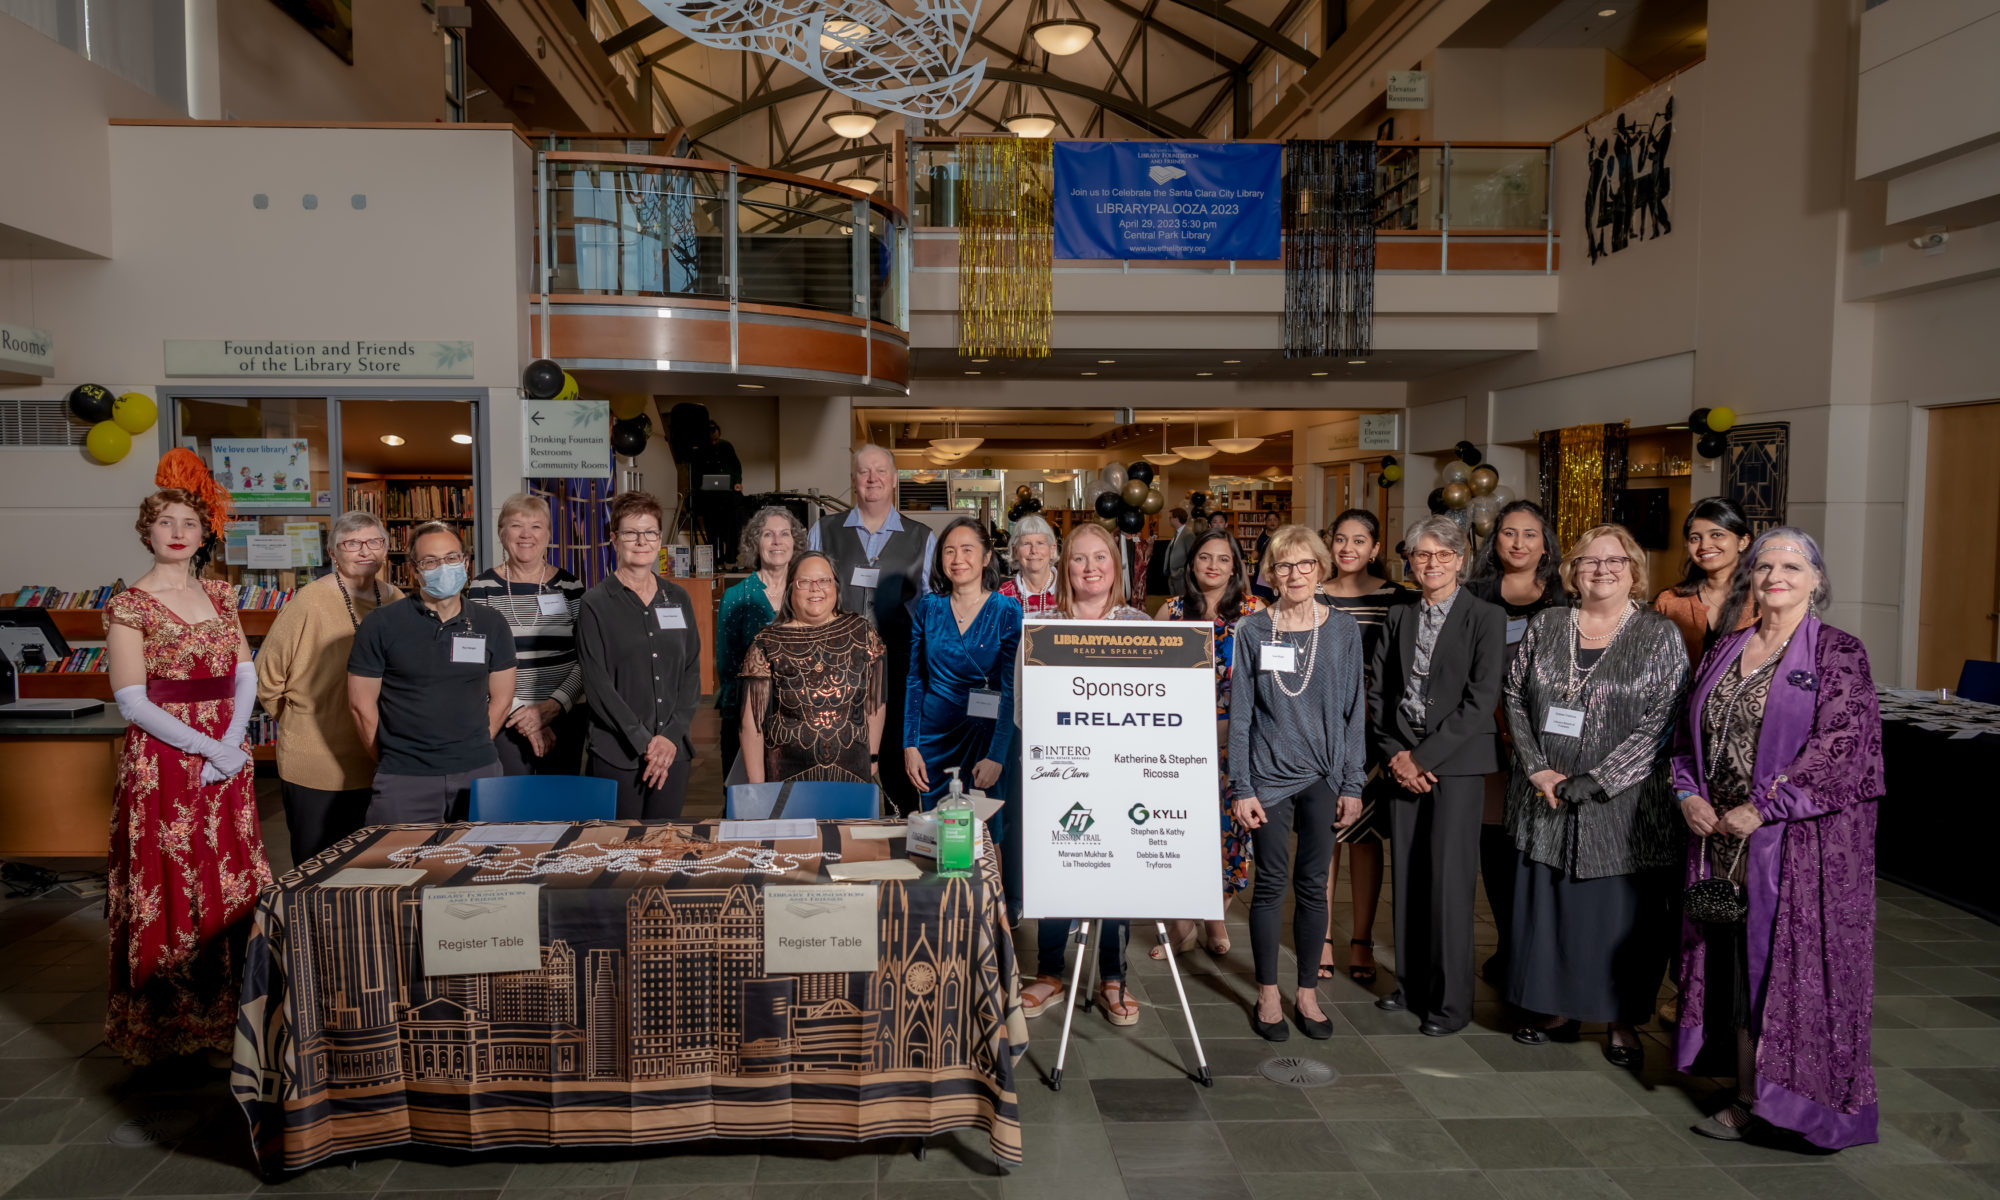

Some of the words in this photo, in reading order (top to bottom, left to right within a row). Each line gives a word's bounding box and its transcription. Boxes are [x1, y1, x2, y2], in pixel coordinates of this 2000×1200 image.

[1070, 188, 1087, 196] Join
[1112, 188, 1151, 197] Celebrate
[1153, 189, 1166, 198] the
[1169, 189, 1192, 198] Santa
[1194, 189, 1216, 198] Clara
[1218, 189, 1235, 200] City
[1237, 190, 1264, 200] Library
[1096, 203, 1207, 215] LIBRARYPALOOZA
[1210, 204, 1239, 215] 2023
[1119, 219, 1139, 230] April
[1141, 220, 1155, 230] 29,
[1158, 219, 1180, 228] 2023
[1182, 220, 1201, 228] 5:30
[1203, 222, 1217, 230] pm
[1124, 231, 1156, 239] Central
[1158, 231, 1178, 239] Park
[1181, 231, 1211, 241] Library
[2, 330, 46, 356] Rooms
[224, 341, 315, 355] Foundation
[322, 341, 350, 355] and
[357, 341, 415, 355] Friends
[239, 358, 256, 372] of
[262, 358, 287, 372] the
[294, 358, 351, 374] Library
[358, 358, 401, 372] Store
[530, 435, 566, 444] Drinking
[568, 435, 603, 443] Fountain
[261, 445, 288, 454] library!
[531, 461, 578, 470] Community
[581, 461, 608, 469] Rooms
[1054, 634, 1157, 646] LIBRARYPALOOZA
[1159, 636, 1183, 647] 2023
[1072, 676, 1166, 700] Sponsors
[1075, 712, 1182, 726] RELATED
[1045, 746, 1091, 756] INTERO
[1114, 754, 1157, 764] Katherine
[1160, 754, 1167, 764] &
[1169, 754, 1207, 765] Stephen
[1031, 766, 1060, 780] Santa
[1062, 766, 1089, 780] Clara
[1143, 768, 1179, 778] Ricossa
[1153, 810, 1187, 819] KYLLI
[1130, 828, 1158, 836] Stephen
[1166, 828, 1185, 836] Kathy
[1073, 861, 1111, 869] Theologides
[438, 938, 487, 951] Register
[491, 936, 524, 947] Table
[779, 937, 826, 949] Register
[830, 936, 862, 947] Table
